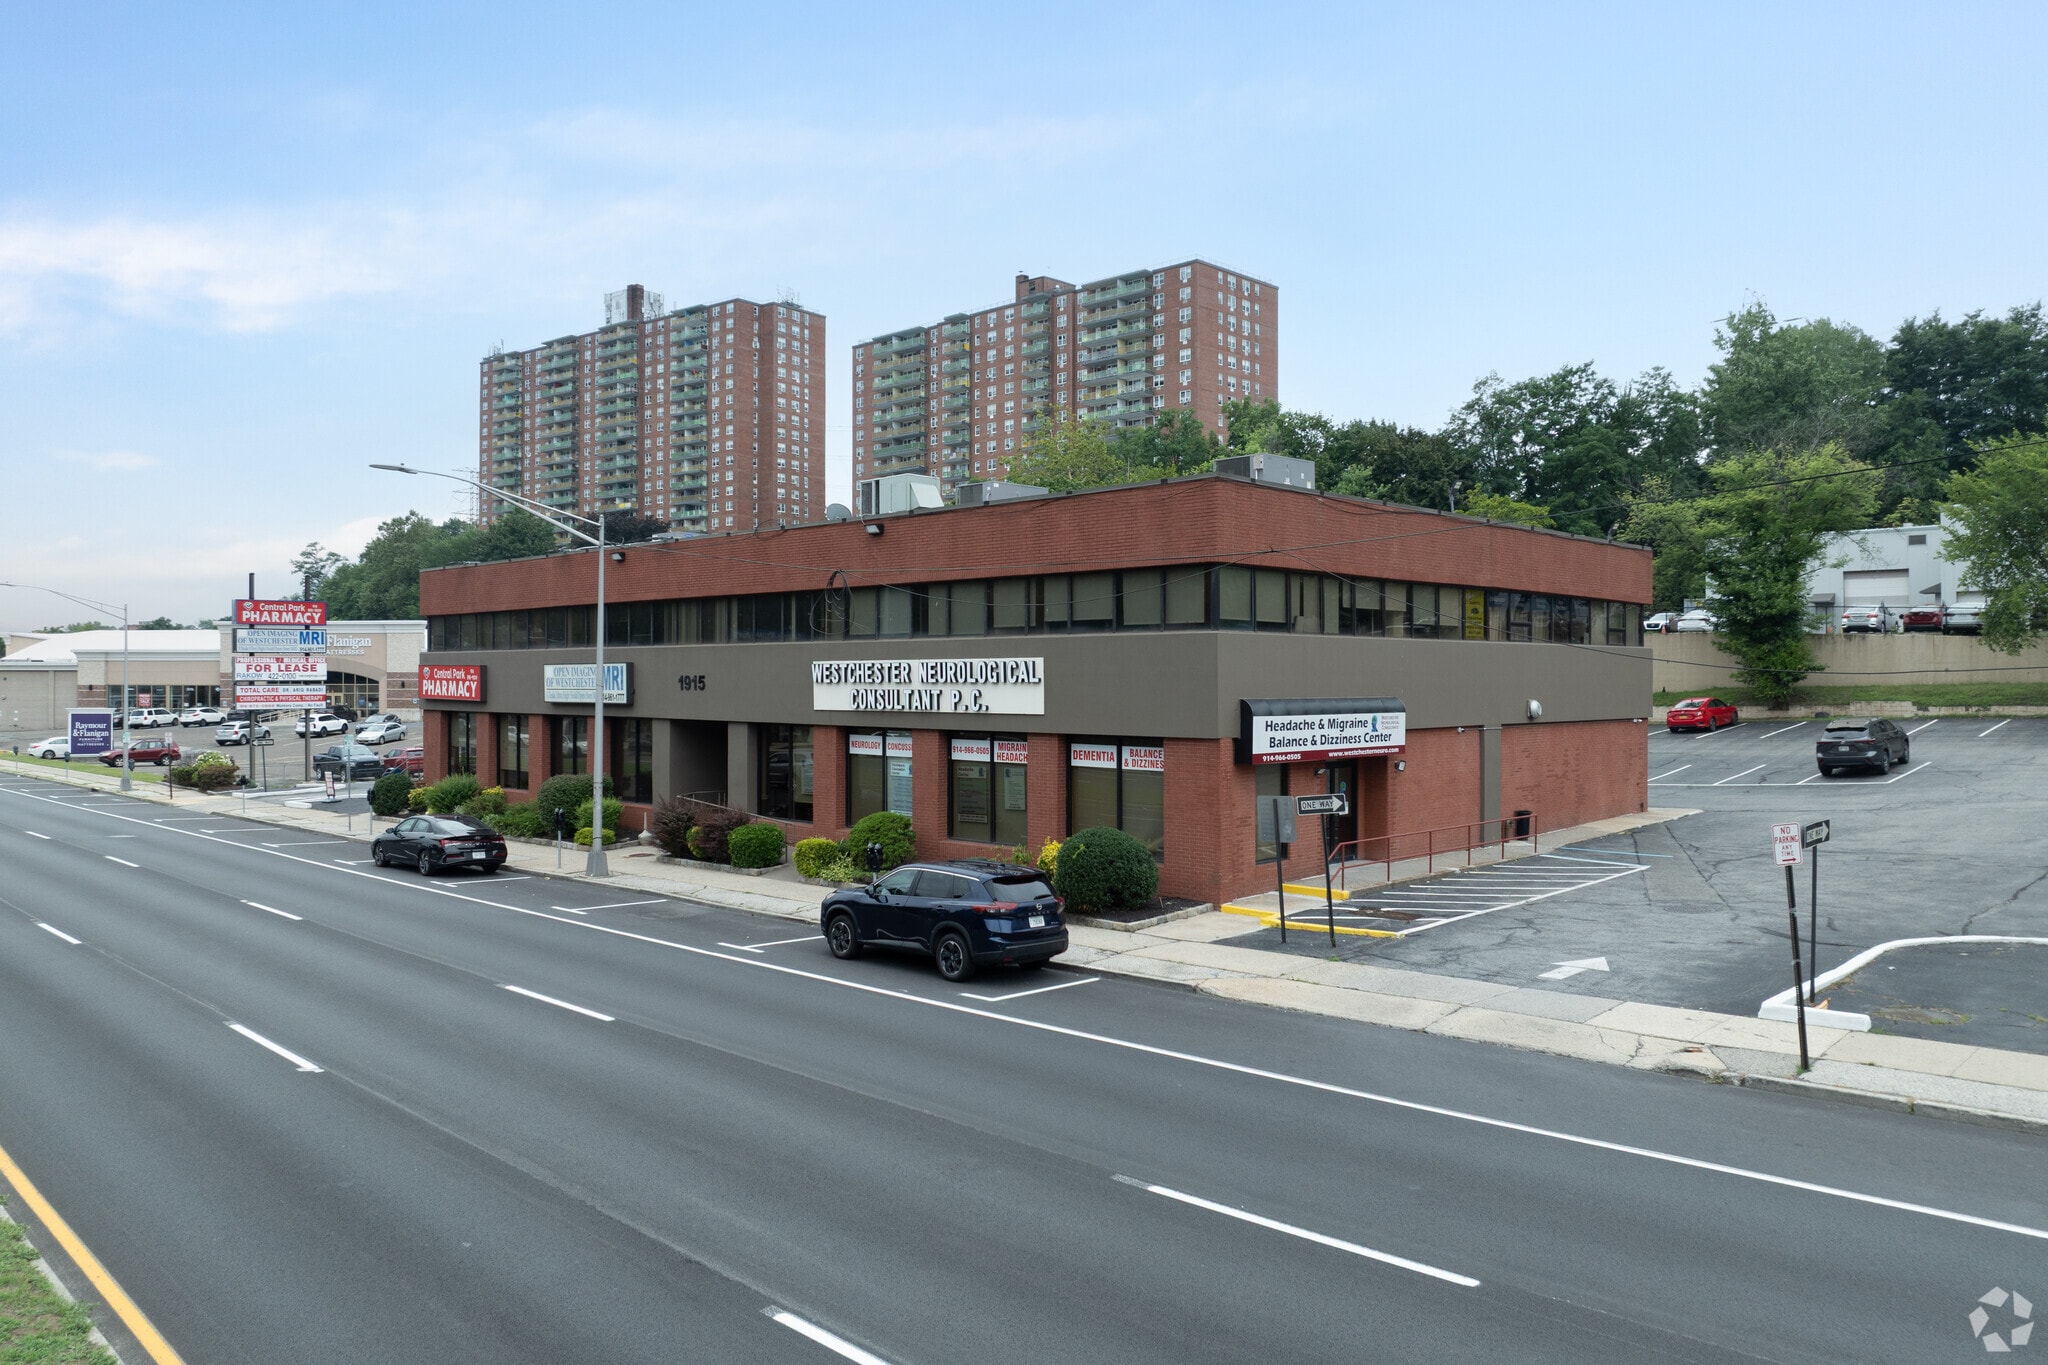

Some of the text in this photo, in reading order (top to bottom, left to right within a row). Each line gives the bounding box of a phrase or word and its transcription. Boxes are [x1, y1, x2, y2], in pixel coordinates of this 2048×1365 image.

[260, 603, 287, 611] Central
[288, 604, 306, 612] Park
[242, 611, 321, 624] PHARMACY
[299, 632, 325, 645] MRI
[327, 635, 372, 649] Flanigan
[246, 664, 318, 672] FOR LEASE
[434, 668, 452, 679] Central
[453, 669, 466, 679] Park
[553, 667, 597, 677] OPEN IMAGIN
[812, 660, 1042, 684] WESTCHESTER NEUROLOGICAL
[546, 677, 596, 687] OF WESTCHESTE
[603, 666, 624, 690] MRI
[678, 675, 706, 691] 1915
[422, 680, 477, 698] PHARMACY
[849, 688, 942, 711] CONSULTANT
[75, 721, 107, 729] Raymour
[1265, 717, 1369, 733] Headache & Migraine
[851, 740, 881, 750] NEUROLOGY
[1269, 732, 1392, 748] Balance & Dizziness Center
[952, 745, 990, 755] 914-966-0505
[1072, 749, 1115, 762] DEMENTIA
[1129, 748, 1163, 759] BALANCE
[1123, 758, 1129, 767] &
[1262, 753, 1301, 762] 914-966-0505
[1302, 800, 1334, 809] ONE WAY
[1780, 826, 1791, 834] NO
[1774, 834, 1799, 843] PARKING
